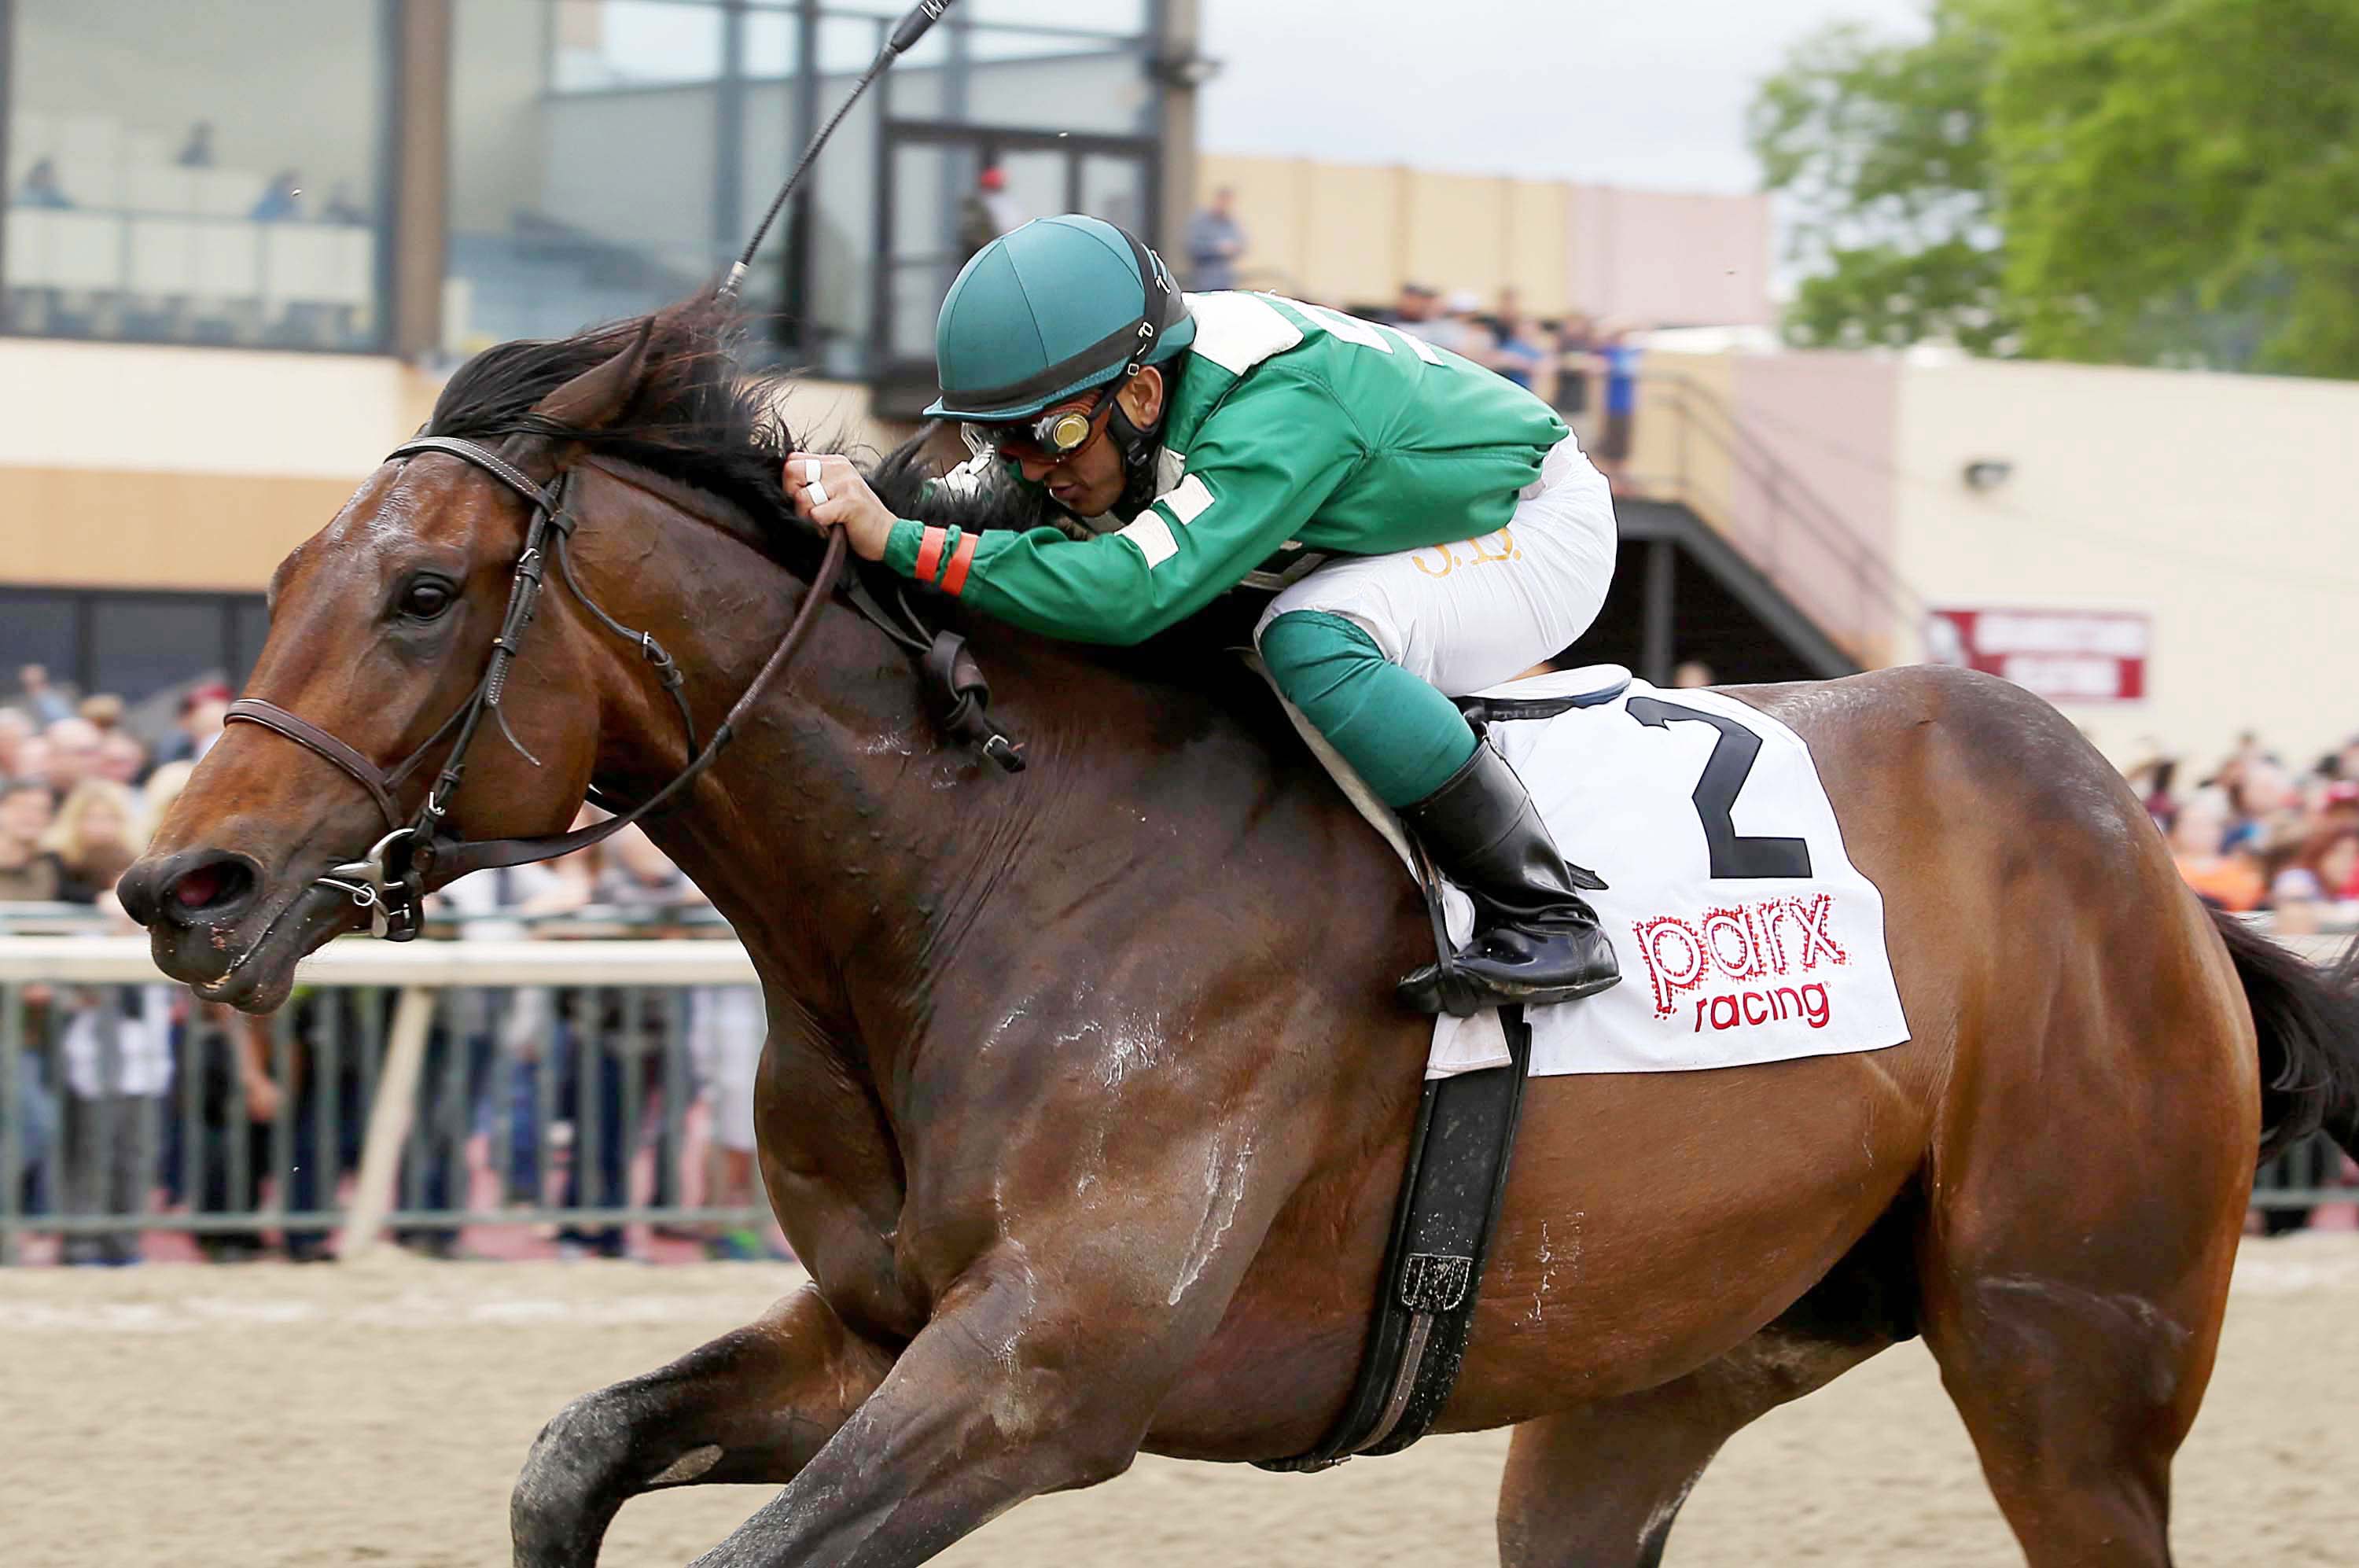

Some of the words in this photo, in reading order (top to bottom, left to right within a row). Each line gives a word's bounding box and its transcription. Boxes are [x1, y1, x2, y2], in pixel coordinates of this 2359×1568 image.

[1625, 697, 1812, 879] 2
[1632, 893, 1848, 1018] parx
[1695, 982, 1831, 1032] racing
